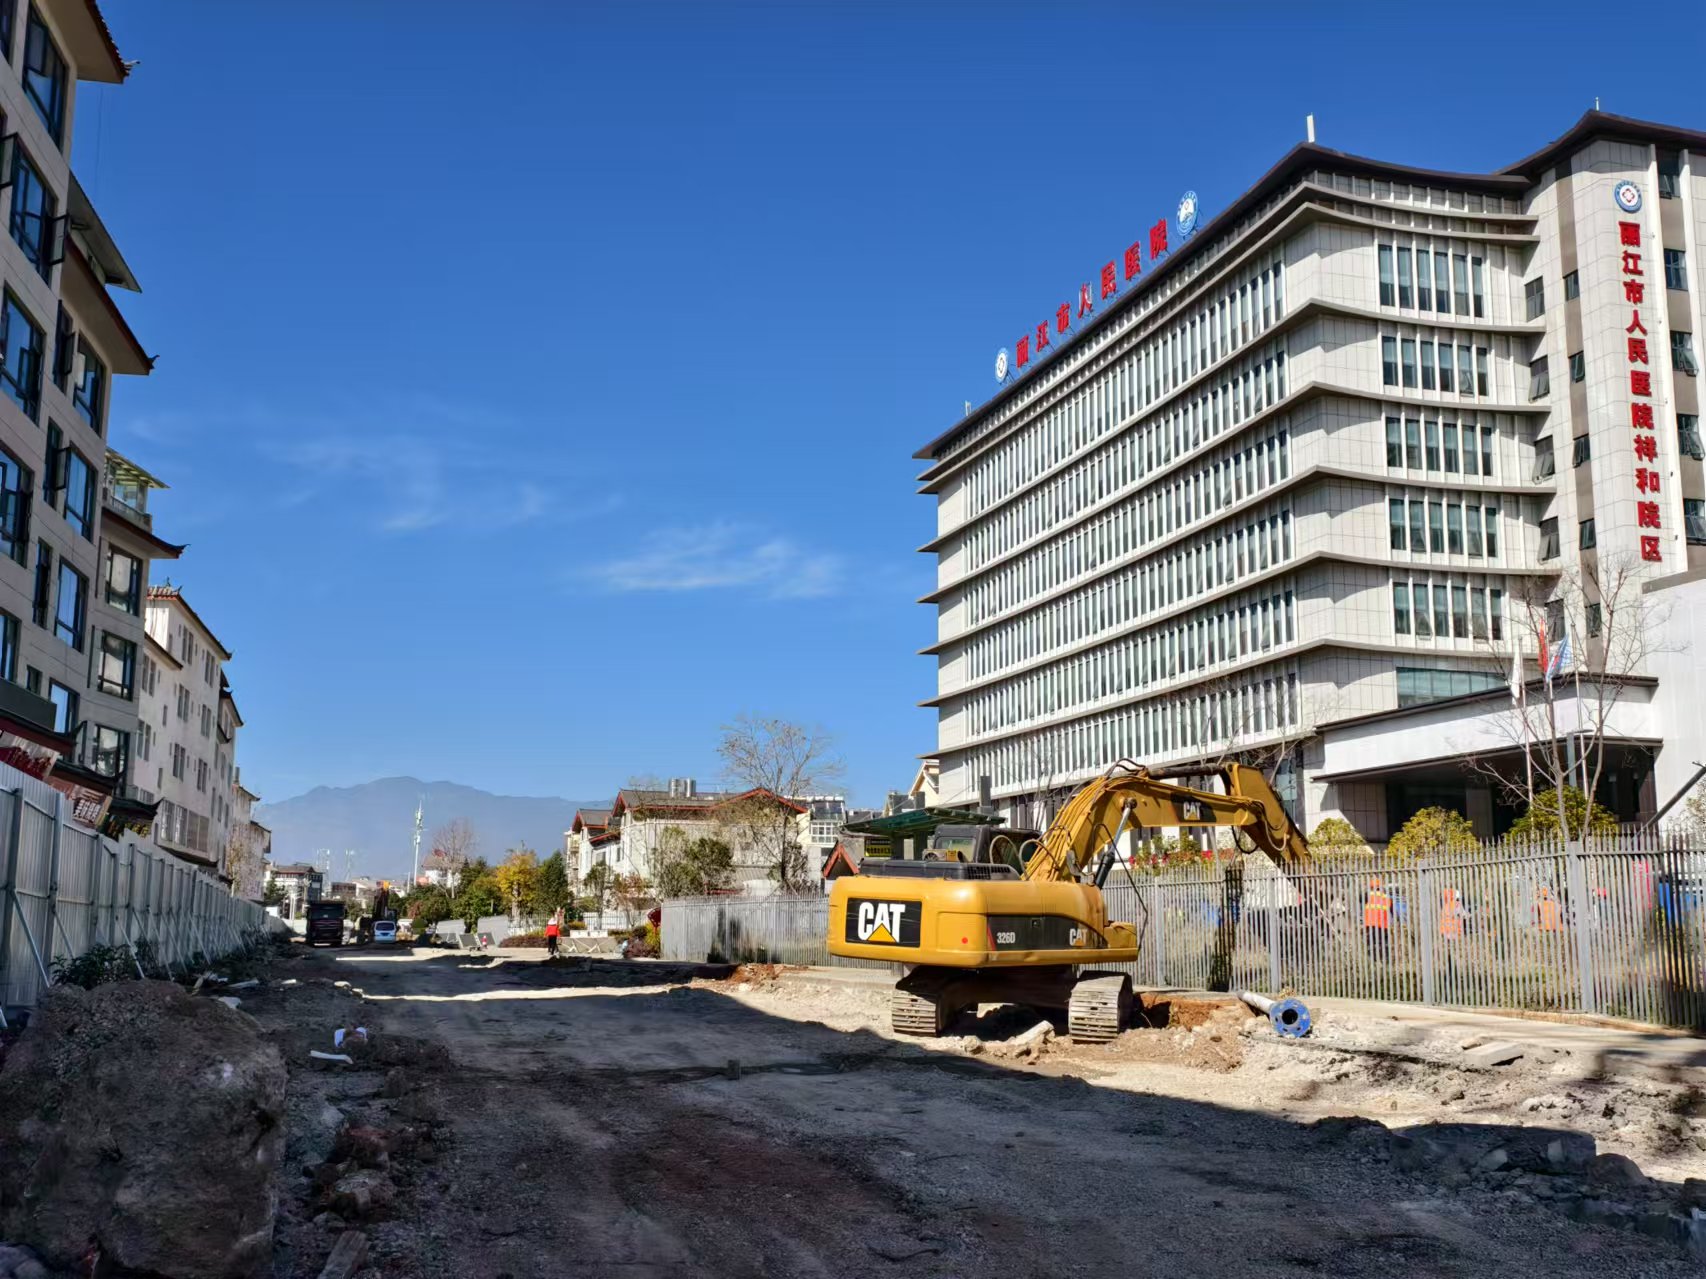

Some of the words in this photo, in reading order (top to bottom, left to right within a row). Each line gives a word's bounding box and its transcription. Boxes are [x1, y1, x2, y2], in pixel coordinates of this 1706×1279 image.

[1016, 218, 1168, 368] 丽江市人民医院
[1618, 221, 1662, 563] 丽江市人民医院祥和院区
[1183, 801, 1201, 820] CAT
[858, 902, 906, 943] CAT
[996, 931, 1016, 944] 326D
[1069, 928, 1087, 946] CAT
